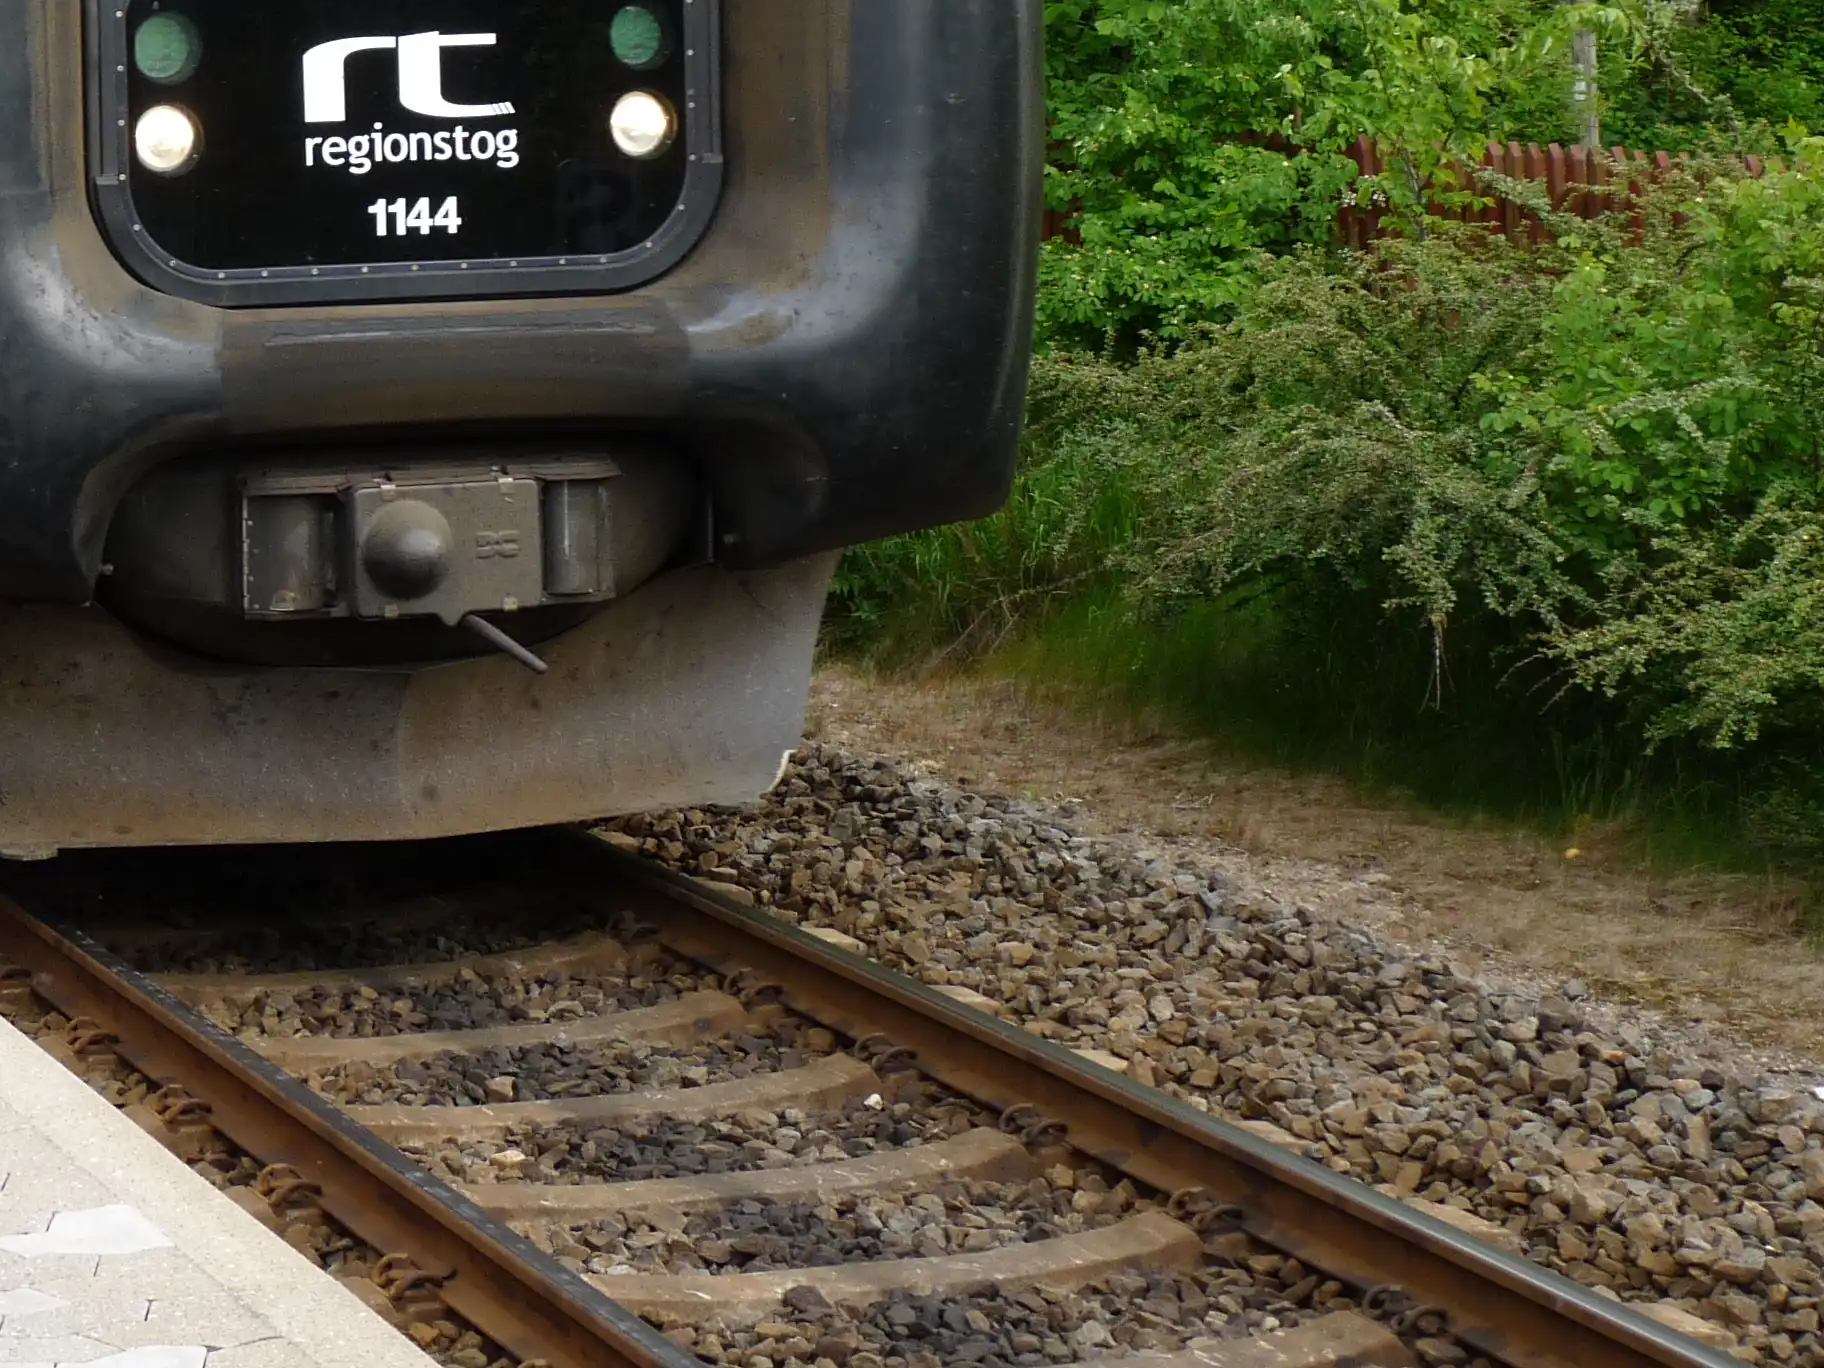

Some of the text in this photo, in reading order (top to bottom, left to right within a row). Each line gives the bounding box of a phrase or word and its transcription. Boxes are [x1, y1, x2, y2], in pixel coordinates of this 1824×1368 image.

[302, 30, 516, 123] rt
[304, 122, 520, 175] regionstog
[367, 195, 462, 237] 1144
